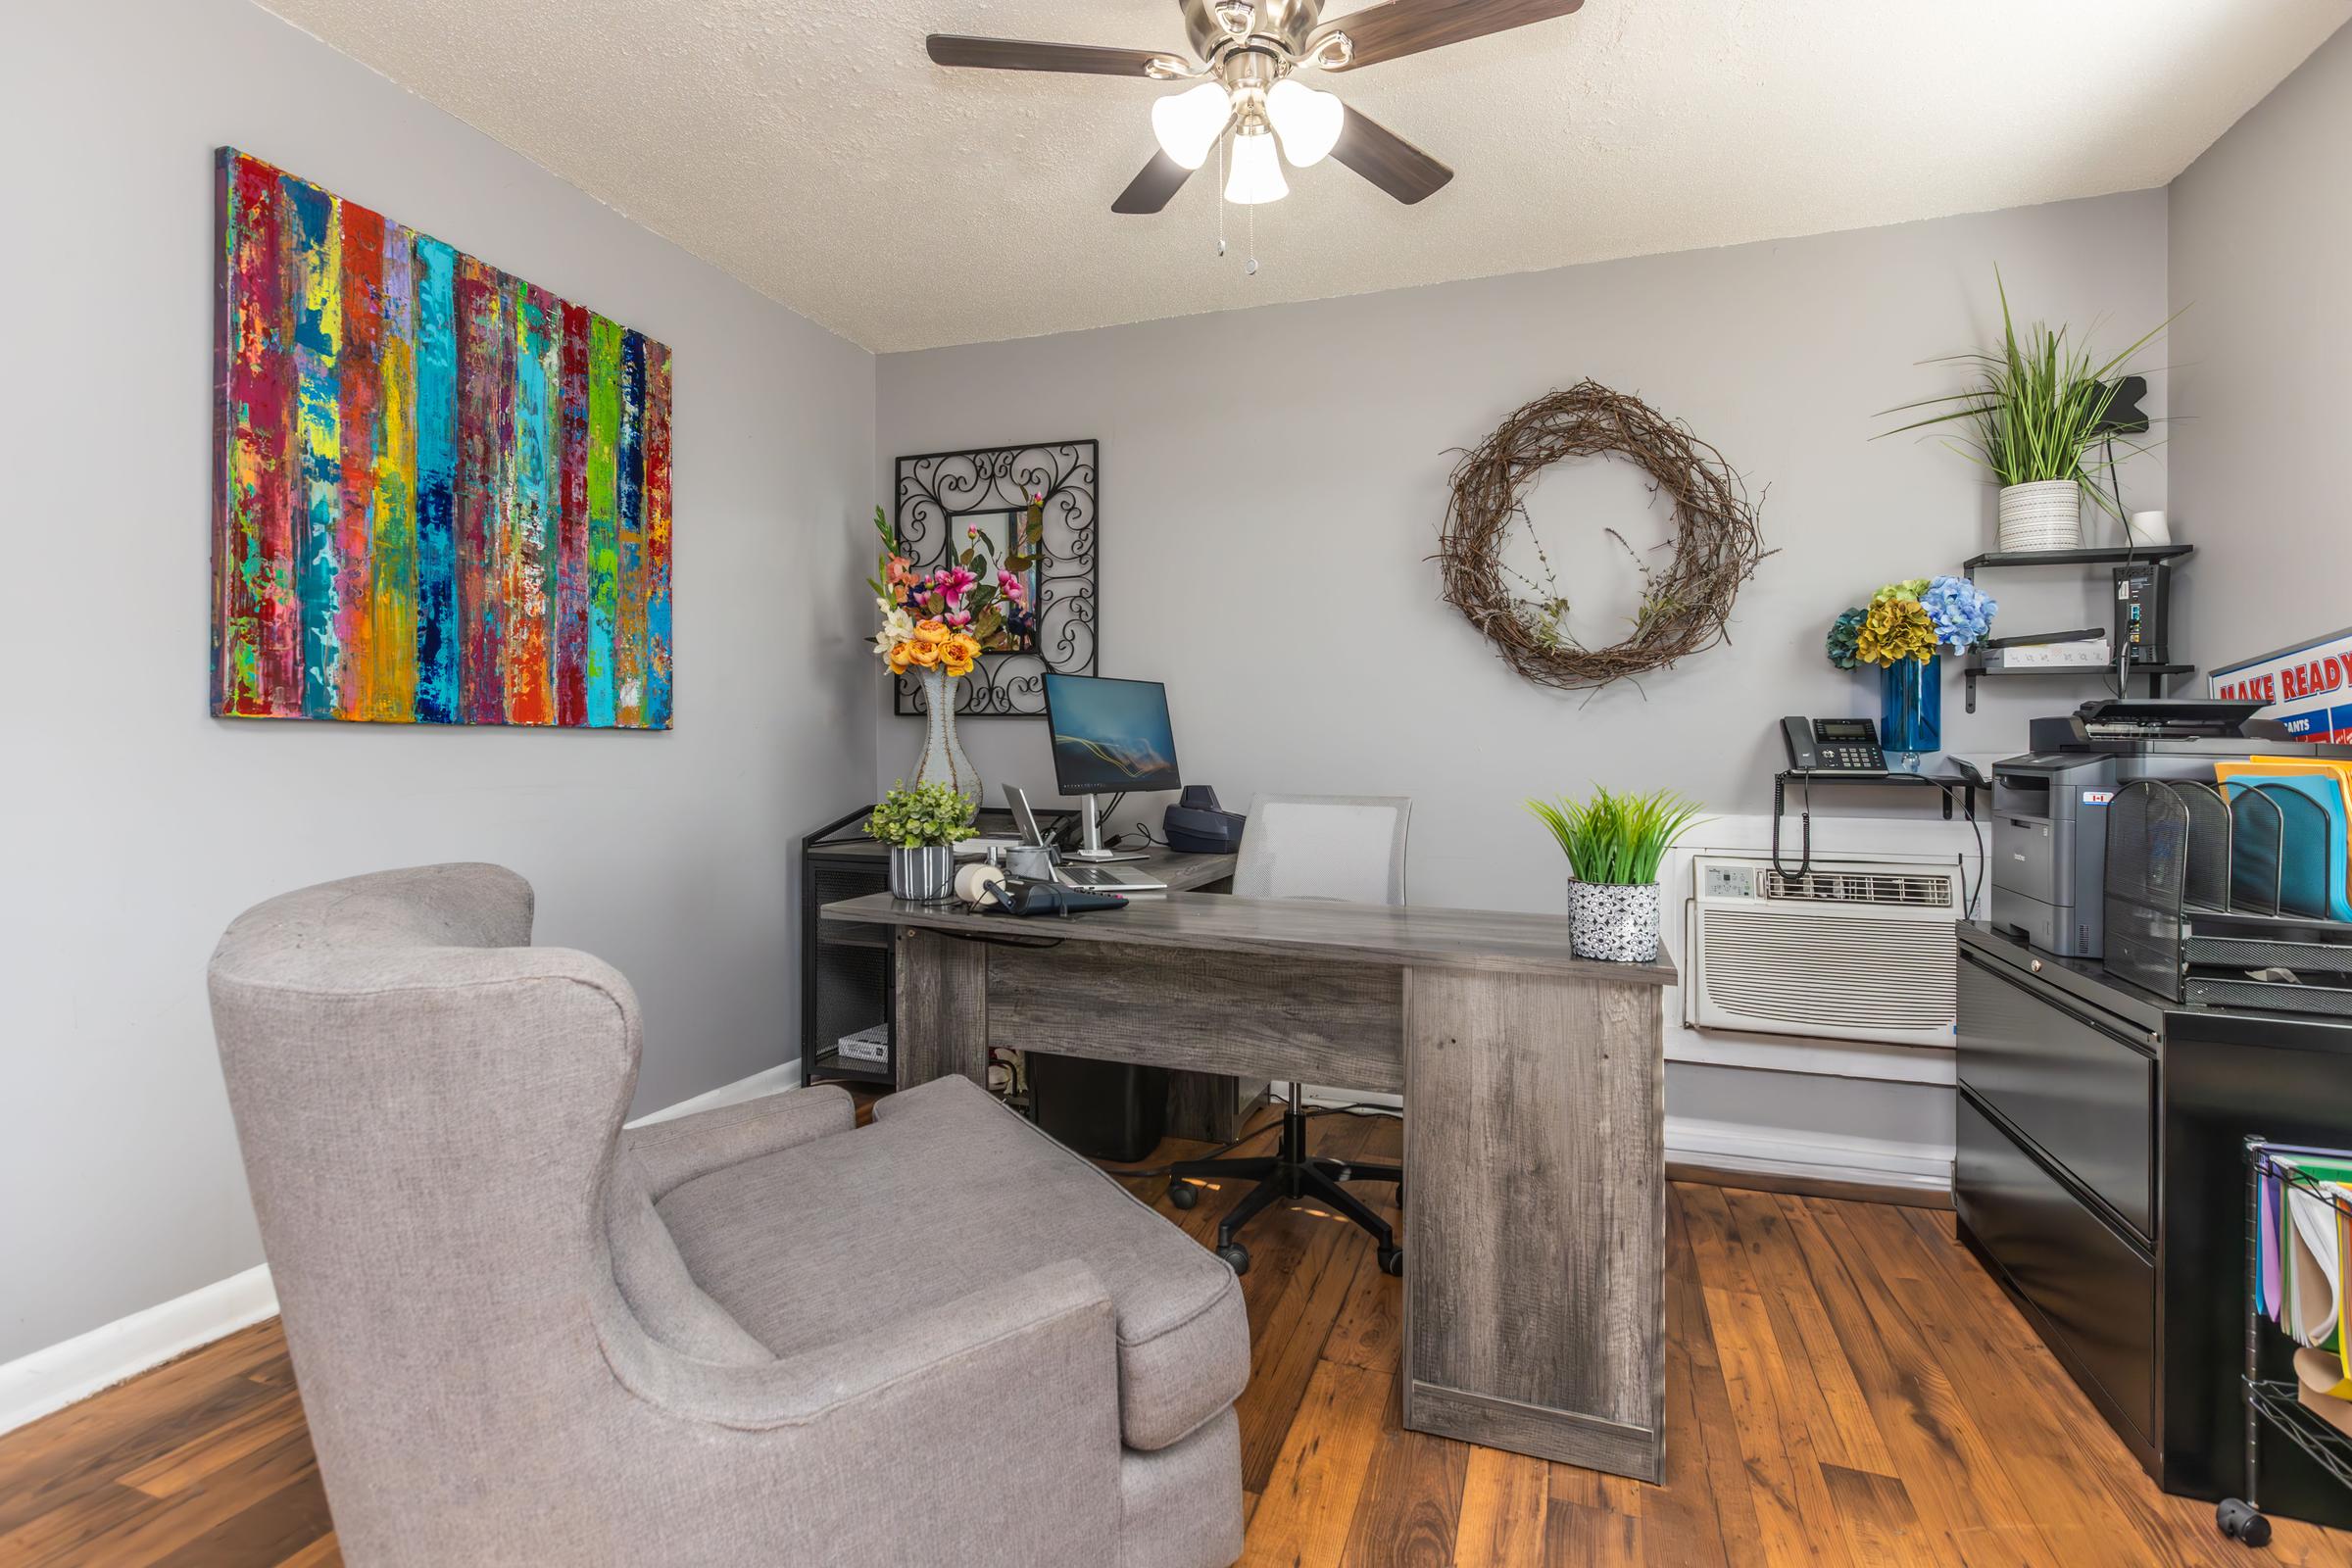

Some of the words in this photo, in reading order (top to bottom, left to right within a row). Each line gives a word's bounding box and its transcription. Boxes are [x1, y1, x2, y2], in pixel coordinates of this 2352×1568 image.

[2219, 672, 2276, 704] MAKE
[2280, 651, 2352, 703] READY
[2284, 718, 2310, 733] ANTS
